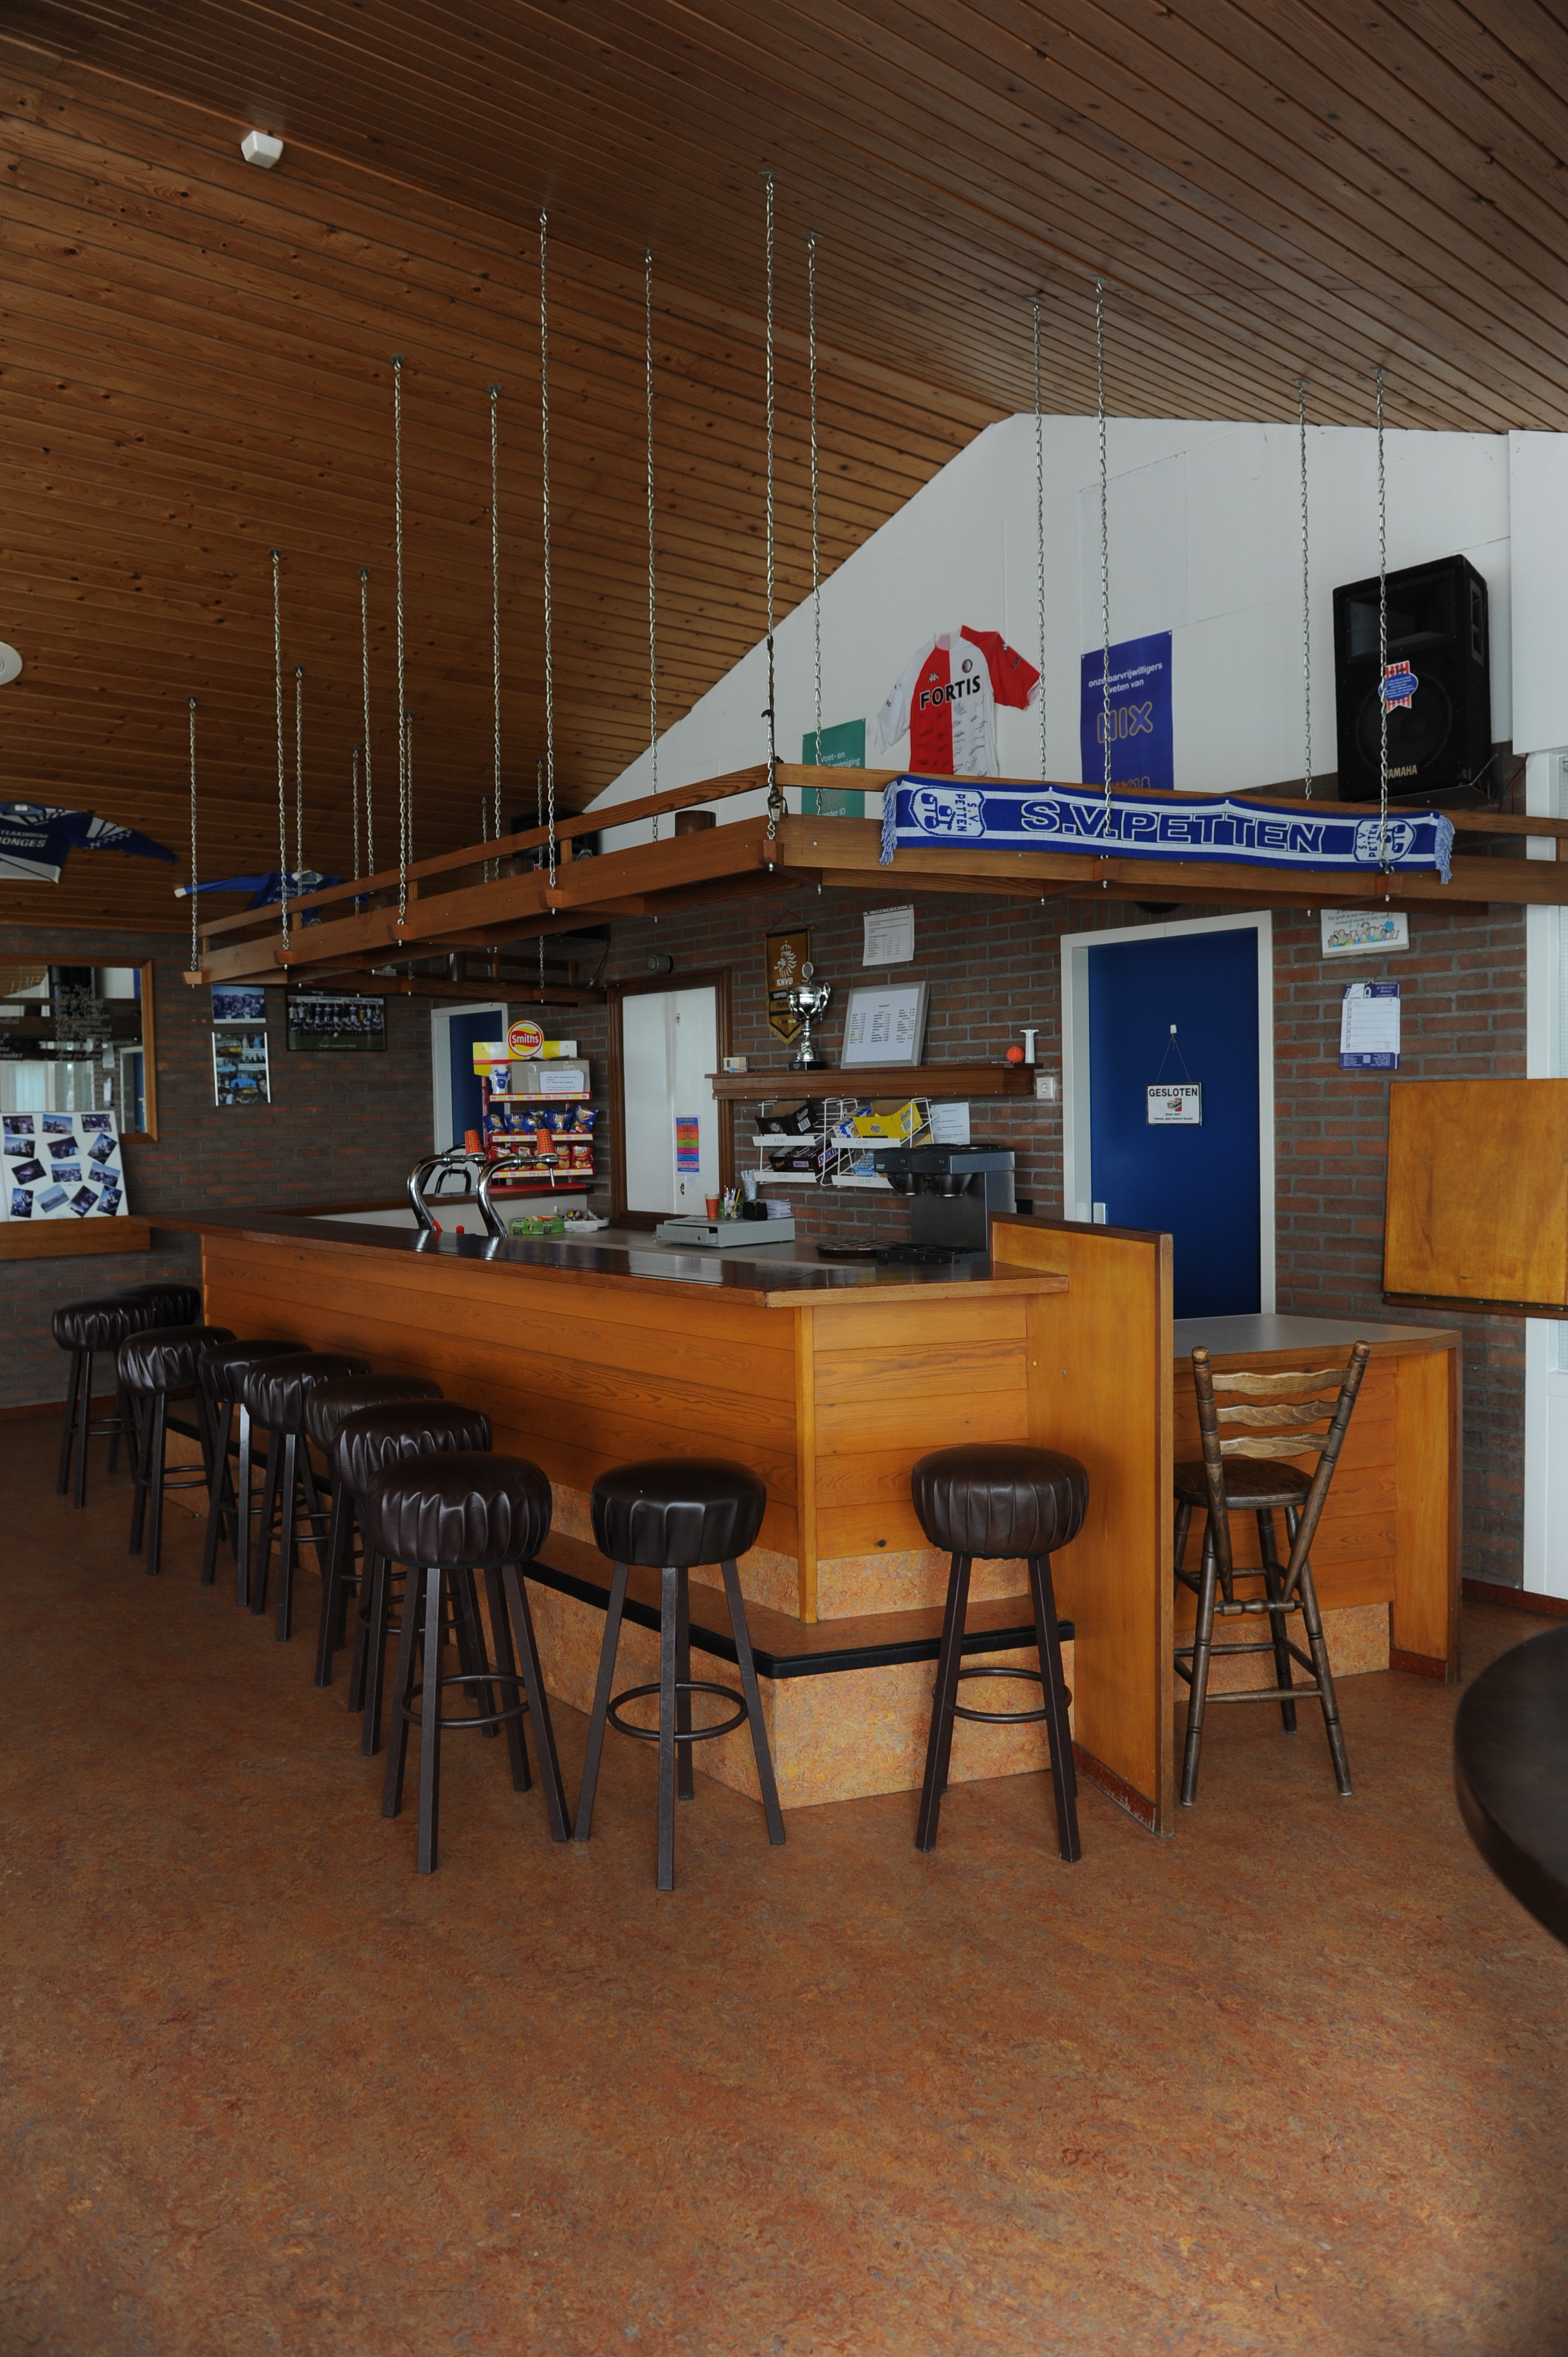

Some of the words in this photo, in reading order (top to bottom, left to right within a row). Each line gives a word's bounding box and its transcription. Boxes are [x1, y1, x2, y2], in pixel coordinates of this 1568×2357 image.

[1088, 677, 1106, 688] onze
[1130, 678, 1144, 688] van
[919, 675, 981, 711] FORTIS
[1097, 701, 1154, 744] NIX
[955, 794, 967, 831] PETTEN
[0, 830, 50, 839] TEAKHOUSE
[1368, 825, 1379, 857] PETTEN
[776, 977, 793, 986] KNVB
[512, 1035, 539, 1043] Smiths
[1149, 1088, 1198, 1097] GESLOTEN
